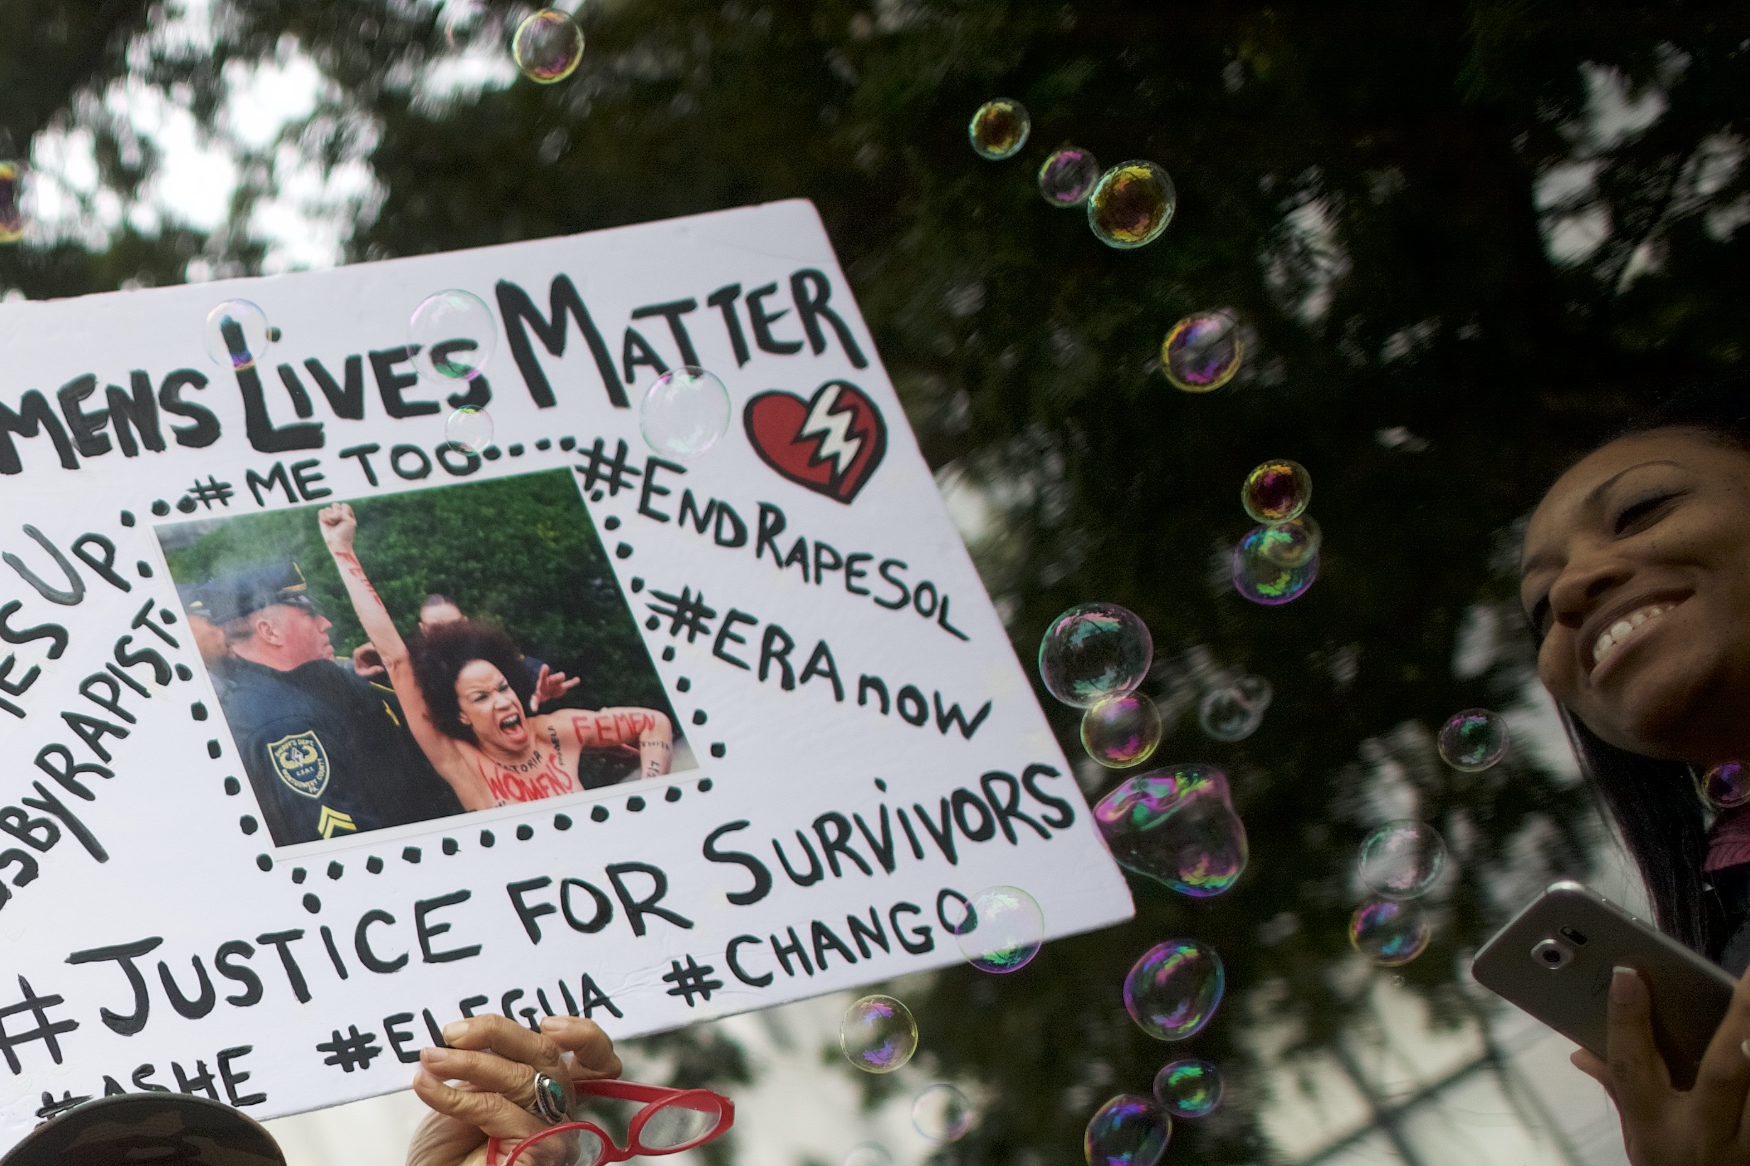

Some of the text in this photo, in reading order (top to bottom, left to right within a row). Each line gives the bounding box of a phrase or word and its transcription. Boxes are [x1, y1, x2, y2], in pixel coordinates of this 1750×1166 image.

[496, 269, 869, 408] MATTER
[505, 861, 695, 944] FOR
[661, 889, 976, 1006] #CHANGO
